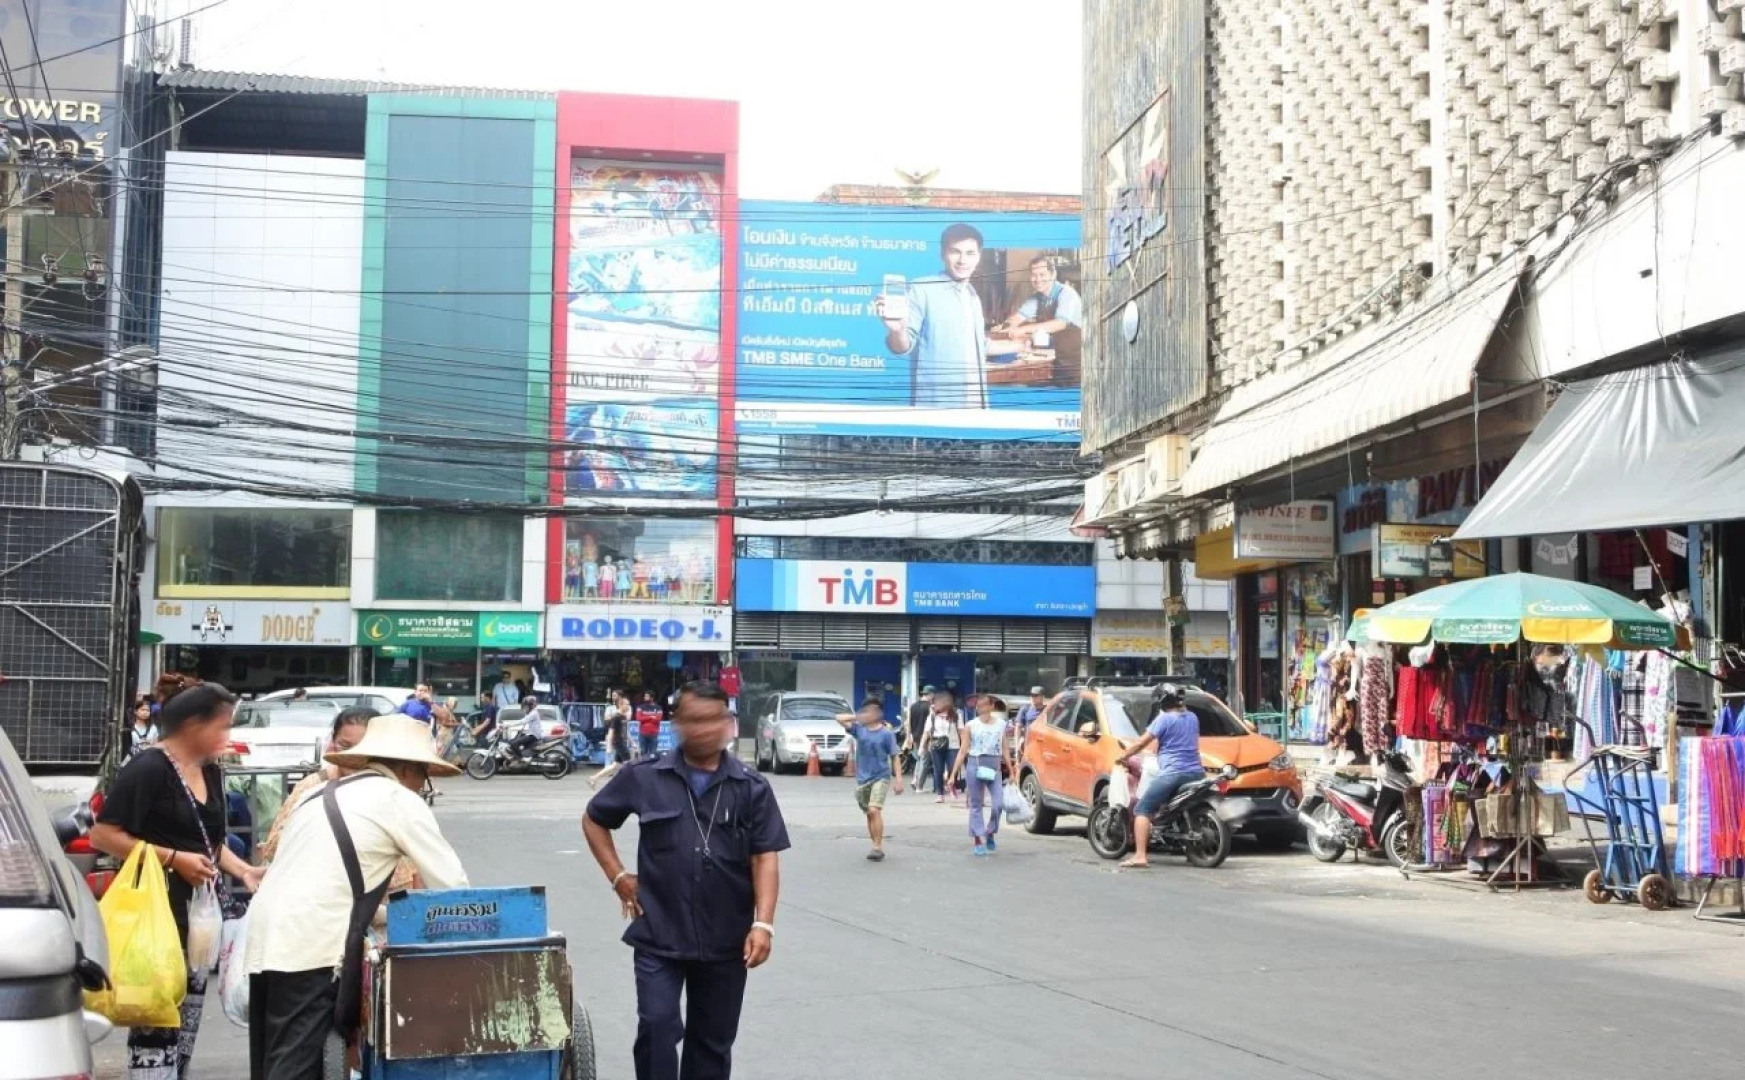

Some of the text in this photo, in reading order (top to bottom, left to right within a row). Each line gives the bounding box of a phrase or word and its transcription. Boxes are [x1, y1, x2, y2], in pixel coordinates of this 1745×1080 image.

[0, 95, 101, 124] OWER
[743, 226, 796, 245] โอนเงิน
[861, 236, 927, 251] ข้ามธนาคาร
[743, 251, 858, 272] ไม่มีค่าธรรมเนียม
[742, 350, 885, 368] TMB SME One Bank
[818, 568, 898, 606] TMB
[914, 600, 960, 608] TMB BANK
[1541, 600, 1593, 613] bank
[261, 613, 316, 643] DODGE
[497, 622, 533, 634] bank
